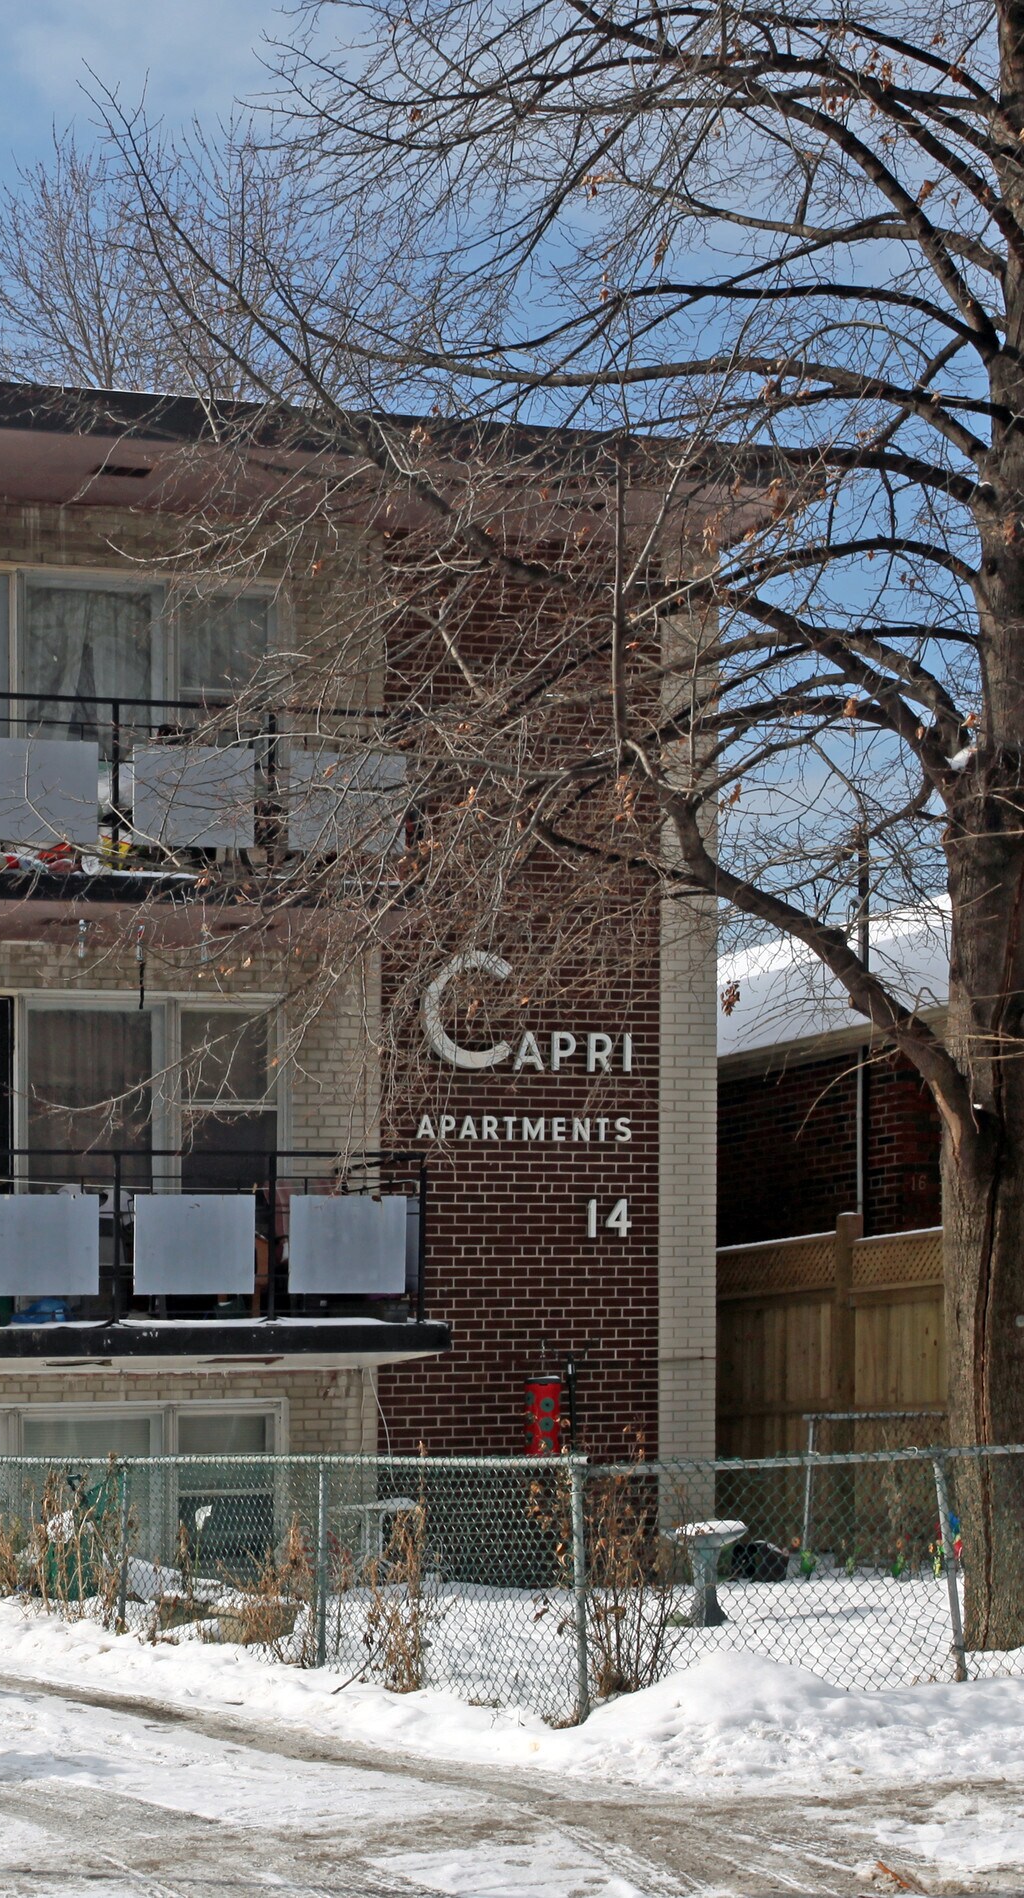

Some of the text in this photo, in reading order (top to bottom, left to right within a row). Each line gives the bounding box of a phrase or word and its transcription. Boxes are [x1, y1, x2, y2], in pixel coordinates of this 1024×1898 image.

[419, 950, 632, 1071] CAPRI
[416, 1115, 632, 1142] APARTMENTS
[912, 1175, 926, 1191] 16
[587, 1199, 632, 1238] 14
